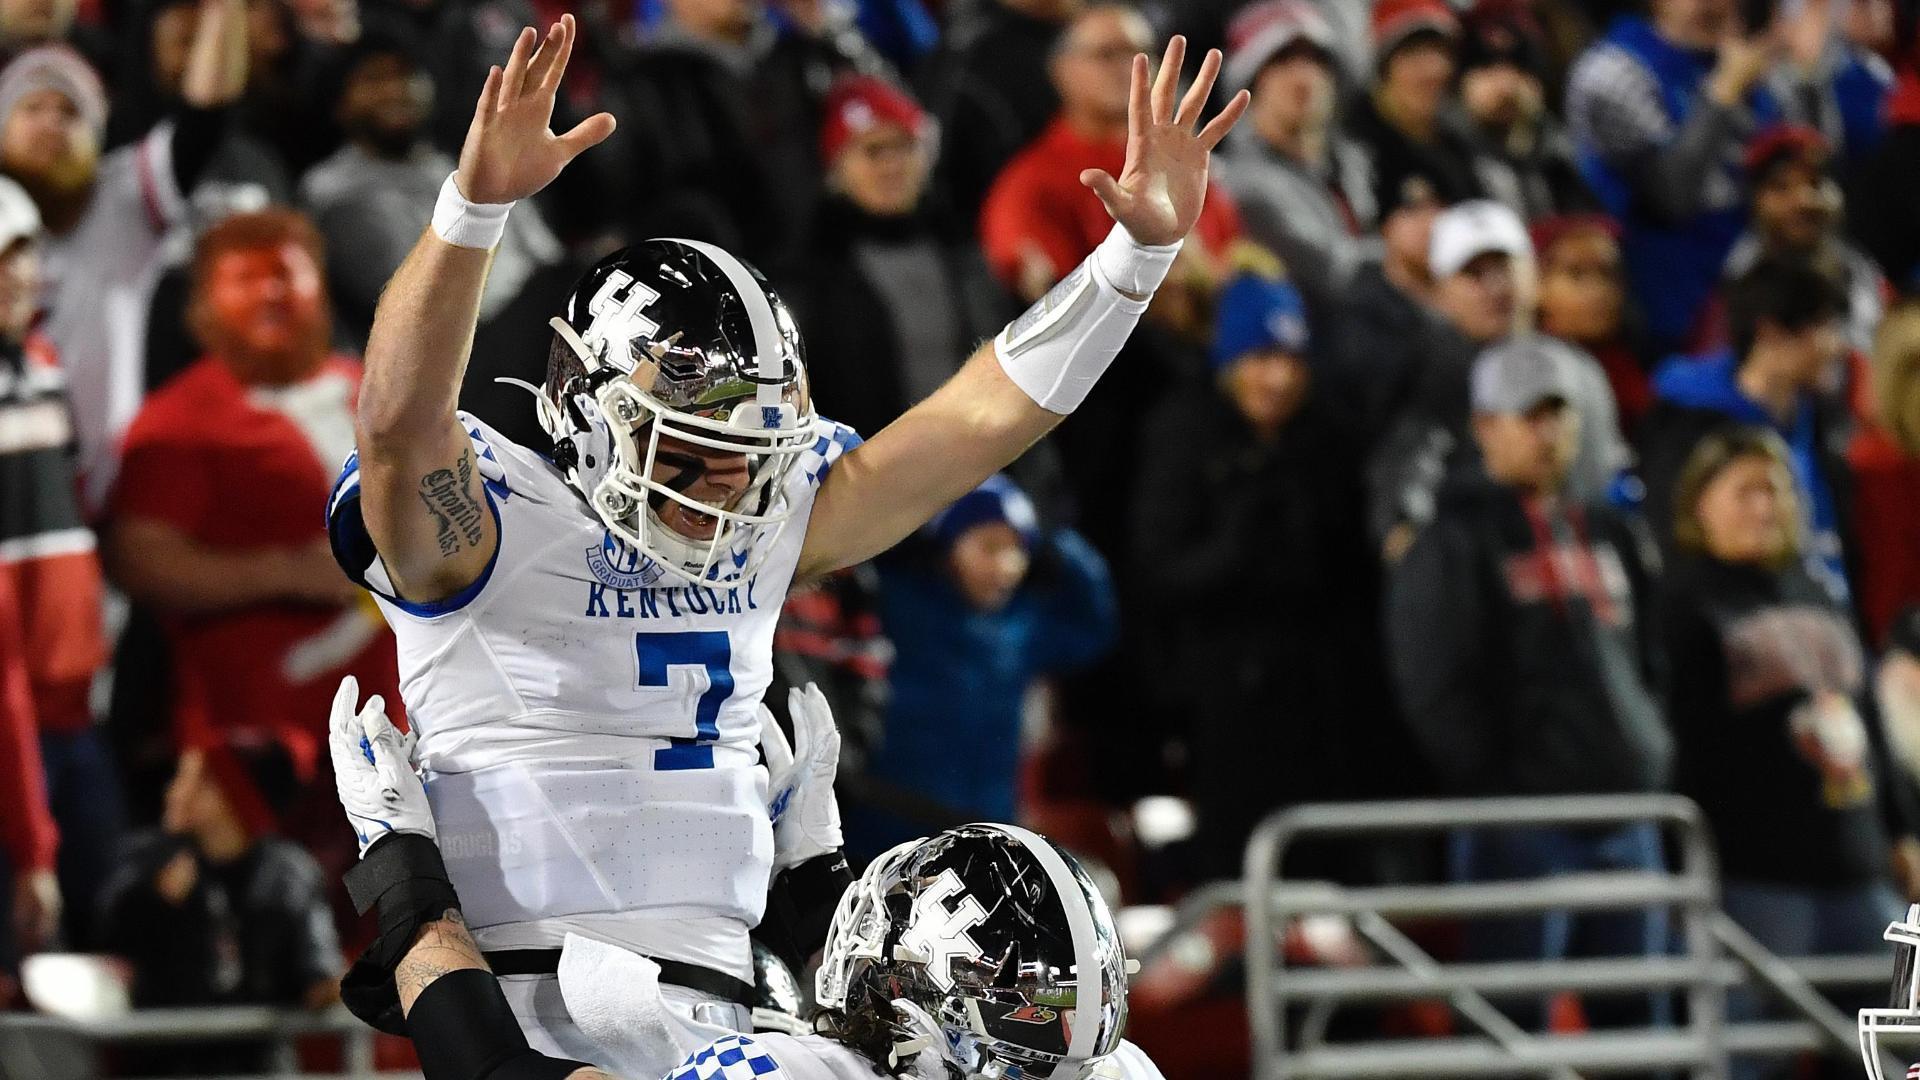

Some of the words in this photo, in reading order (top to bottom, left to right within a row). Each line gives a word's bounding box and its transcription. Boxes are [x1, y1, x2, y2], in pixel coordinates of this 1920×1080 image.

[582, 269, 661, 374] UK
[421, 468, 482, 547] Chronicles
[592, 560, 650, 588] GRADUATE
[636, 631, 735, 770] 7
[900, 868, 989, 994] UK
